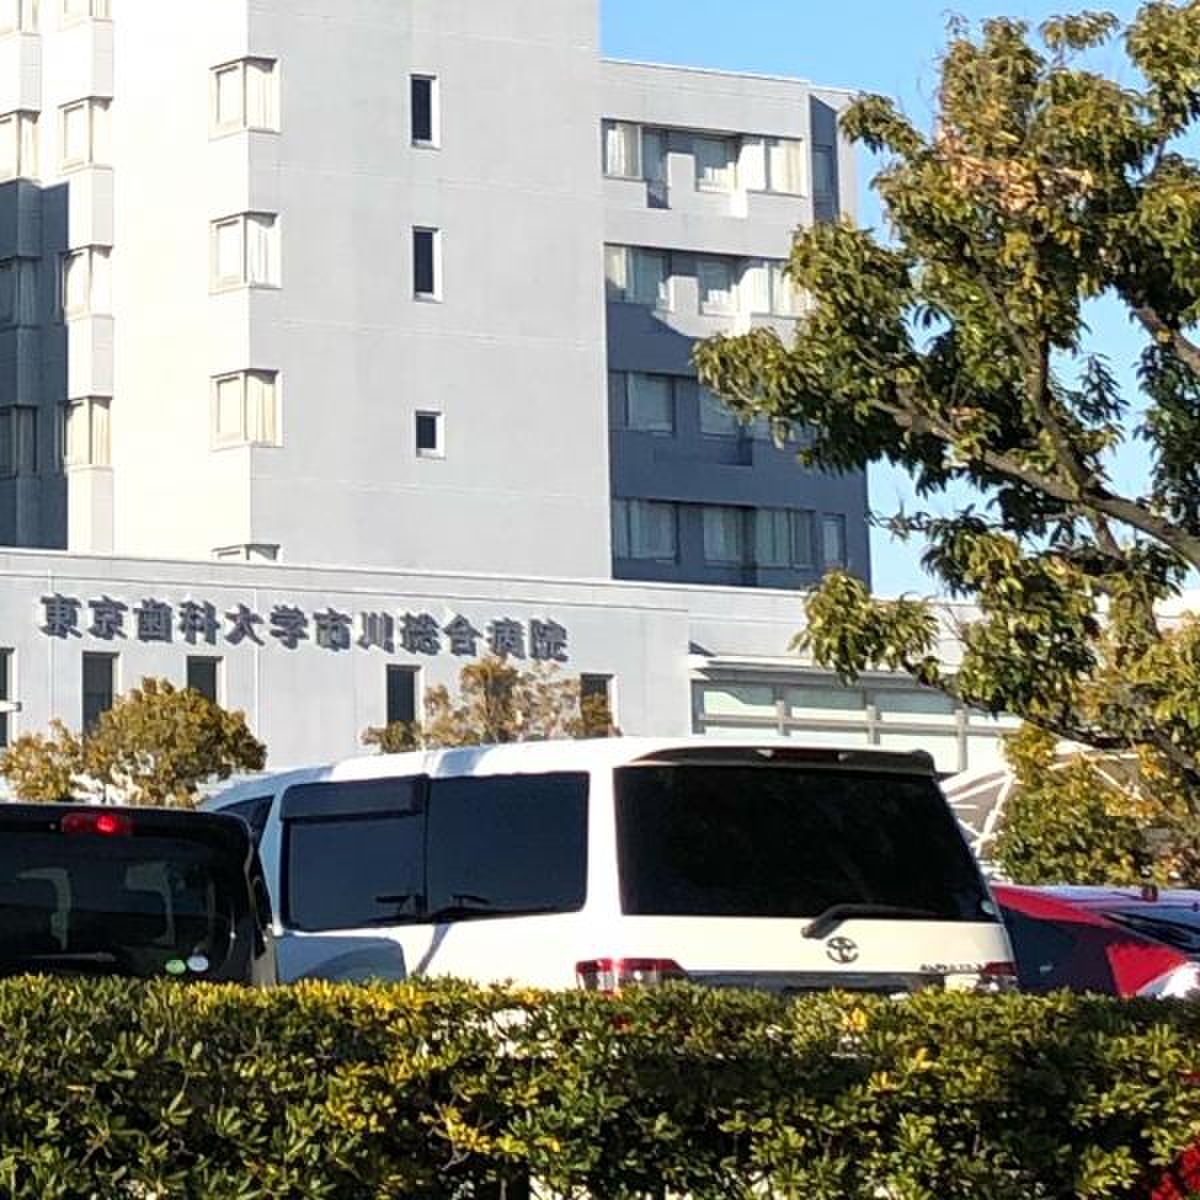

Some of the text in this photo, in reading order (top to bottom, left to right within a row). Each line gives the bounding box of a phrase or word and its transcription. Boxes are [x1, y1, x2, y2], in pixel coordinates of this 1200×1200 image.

[40, 593, 568, 662] 東京歯科大学市川総合病院
